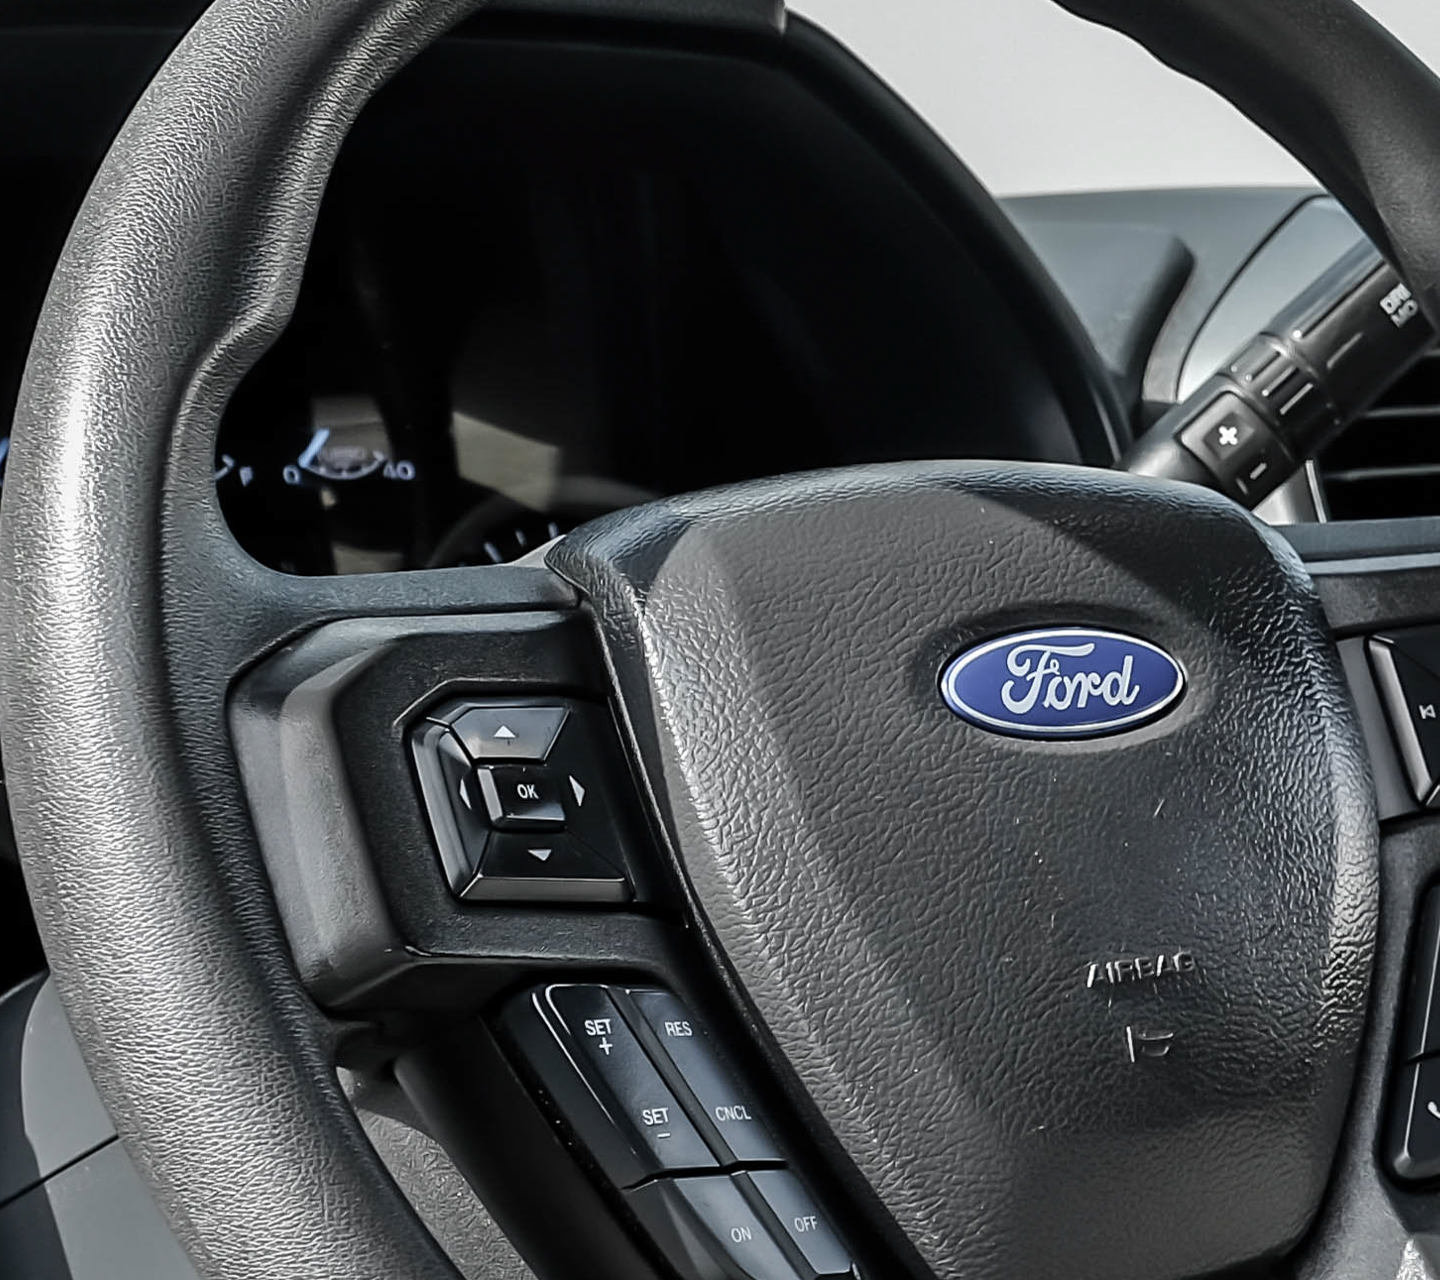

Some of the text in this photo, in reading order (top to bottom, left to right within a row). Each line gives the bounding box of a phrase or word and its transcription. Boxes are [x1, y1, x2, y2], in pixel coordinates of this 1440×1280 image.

[1001, 642, 1140, 714] Ford
[516, 783, 540, 799] OK
[1086, 951, 1195, 989] AIRBAG
[584, 1018, 612, 1037] SET
[664, 1021, 693, 1037] RES
[642, 1107, 670, 1126] SET
[715, 1105, 752, 1121] CNCL
[793, 1216, 817, 1234] OFF
[730, 1226, 753, 1243] ON
